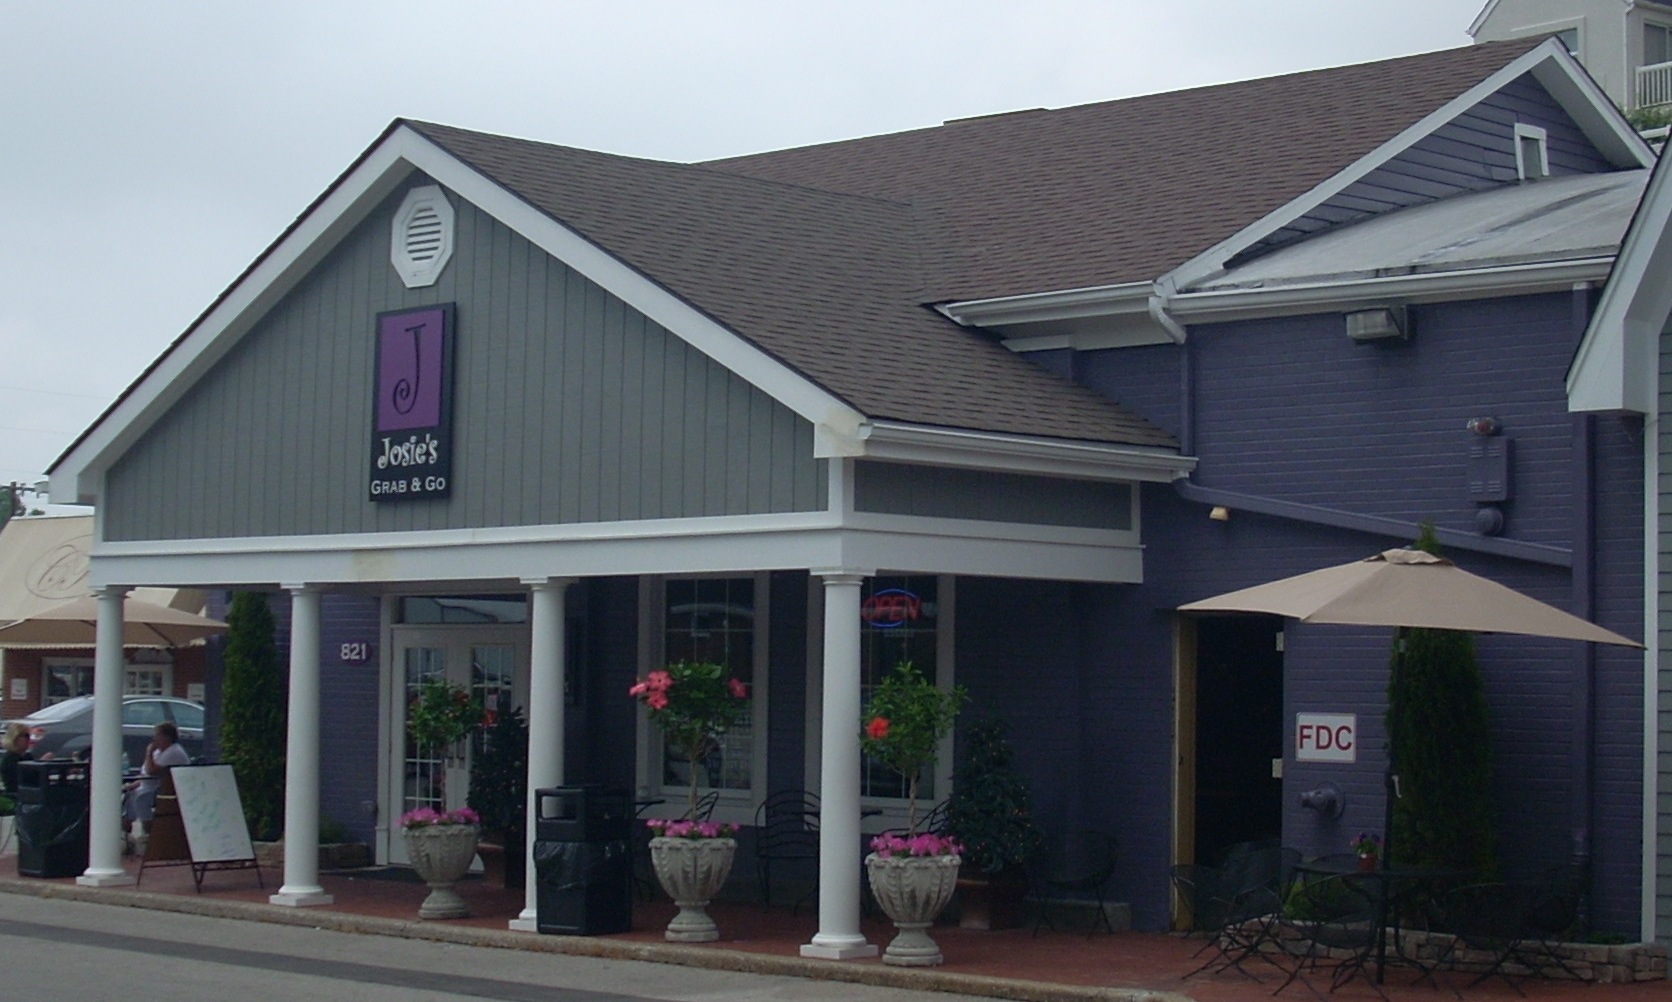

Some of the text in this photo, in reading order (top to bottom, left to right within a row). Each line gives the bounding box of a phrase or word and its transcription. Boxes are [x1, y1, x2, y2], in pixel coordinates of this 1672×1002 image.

[393, 324, 426, 414] J
[377, 433, 438, 469] Josie's
[371, 480, 407, 495] GRAB
[411, 477, 421, 492] &
[861, 595, 920, 621] OPEN
[341, 643, 366, 660] 821
[1299, 725, 1352, 751] FDC
